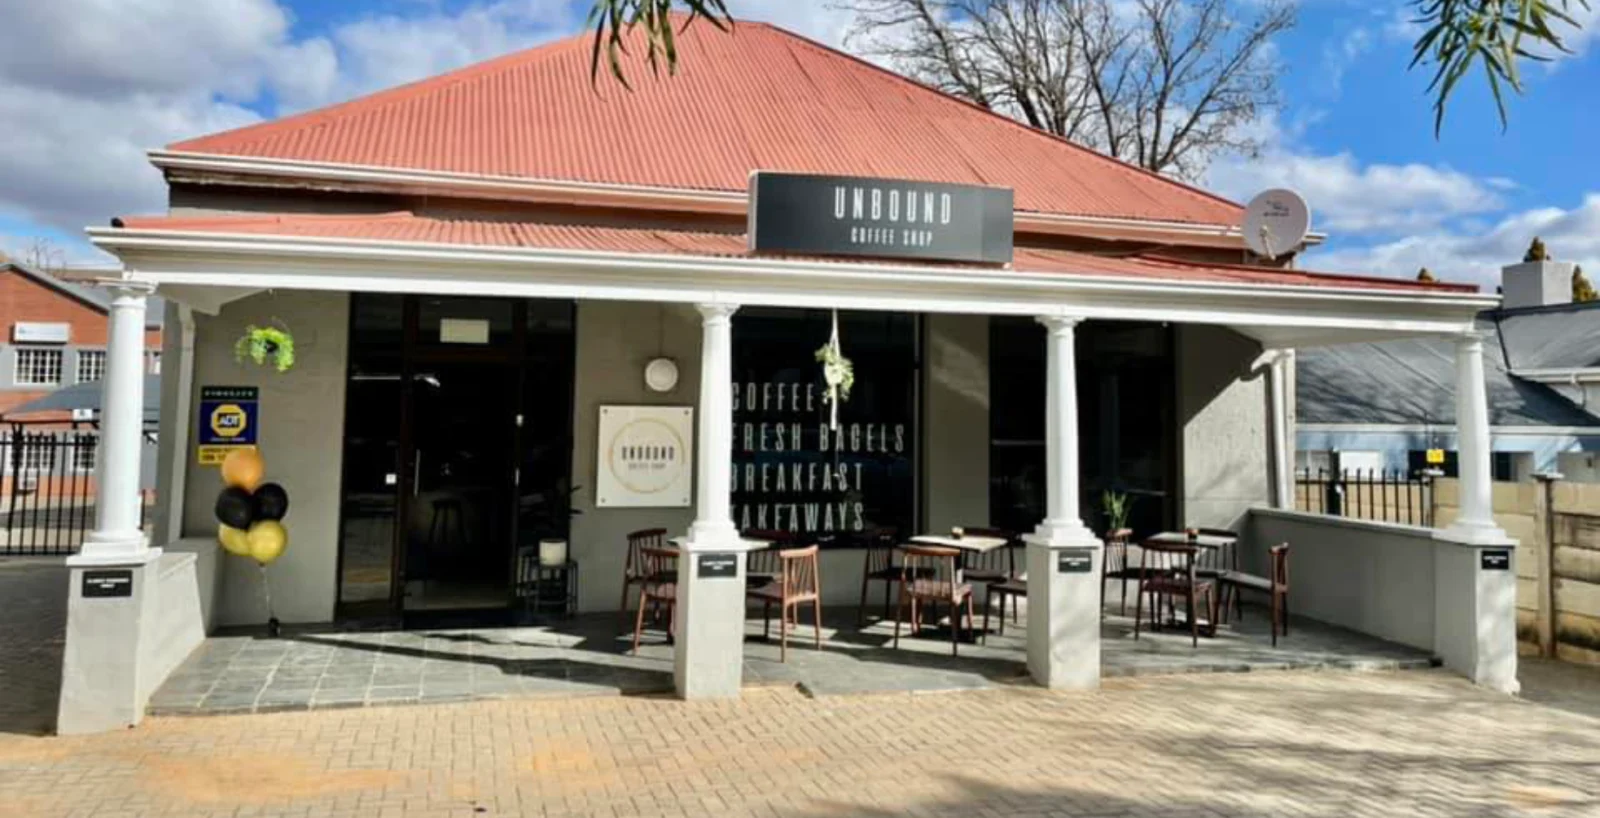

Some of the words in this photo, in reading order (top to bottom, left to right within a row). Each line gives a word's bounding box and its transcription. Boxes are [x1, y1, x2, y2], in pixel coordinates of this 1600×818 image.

[835, 186, 951, 225] UNBOUND
[851, 226, 895, 245] COFFEE
[903, 229, 932, 247] SHOP
[731, 382, 814, 412] COFFEE
[218, 415, 240, 426] ADT
[819, 423, 904, 452] BAGELS
[731, 462, 862, 492] BREAKFAST
